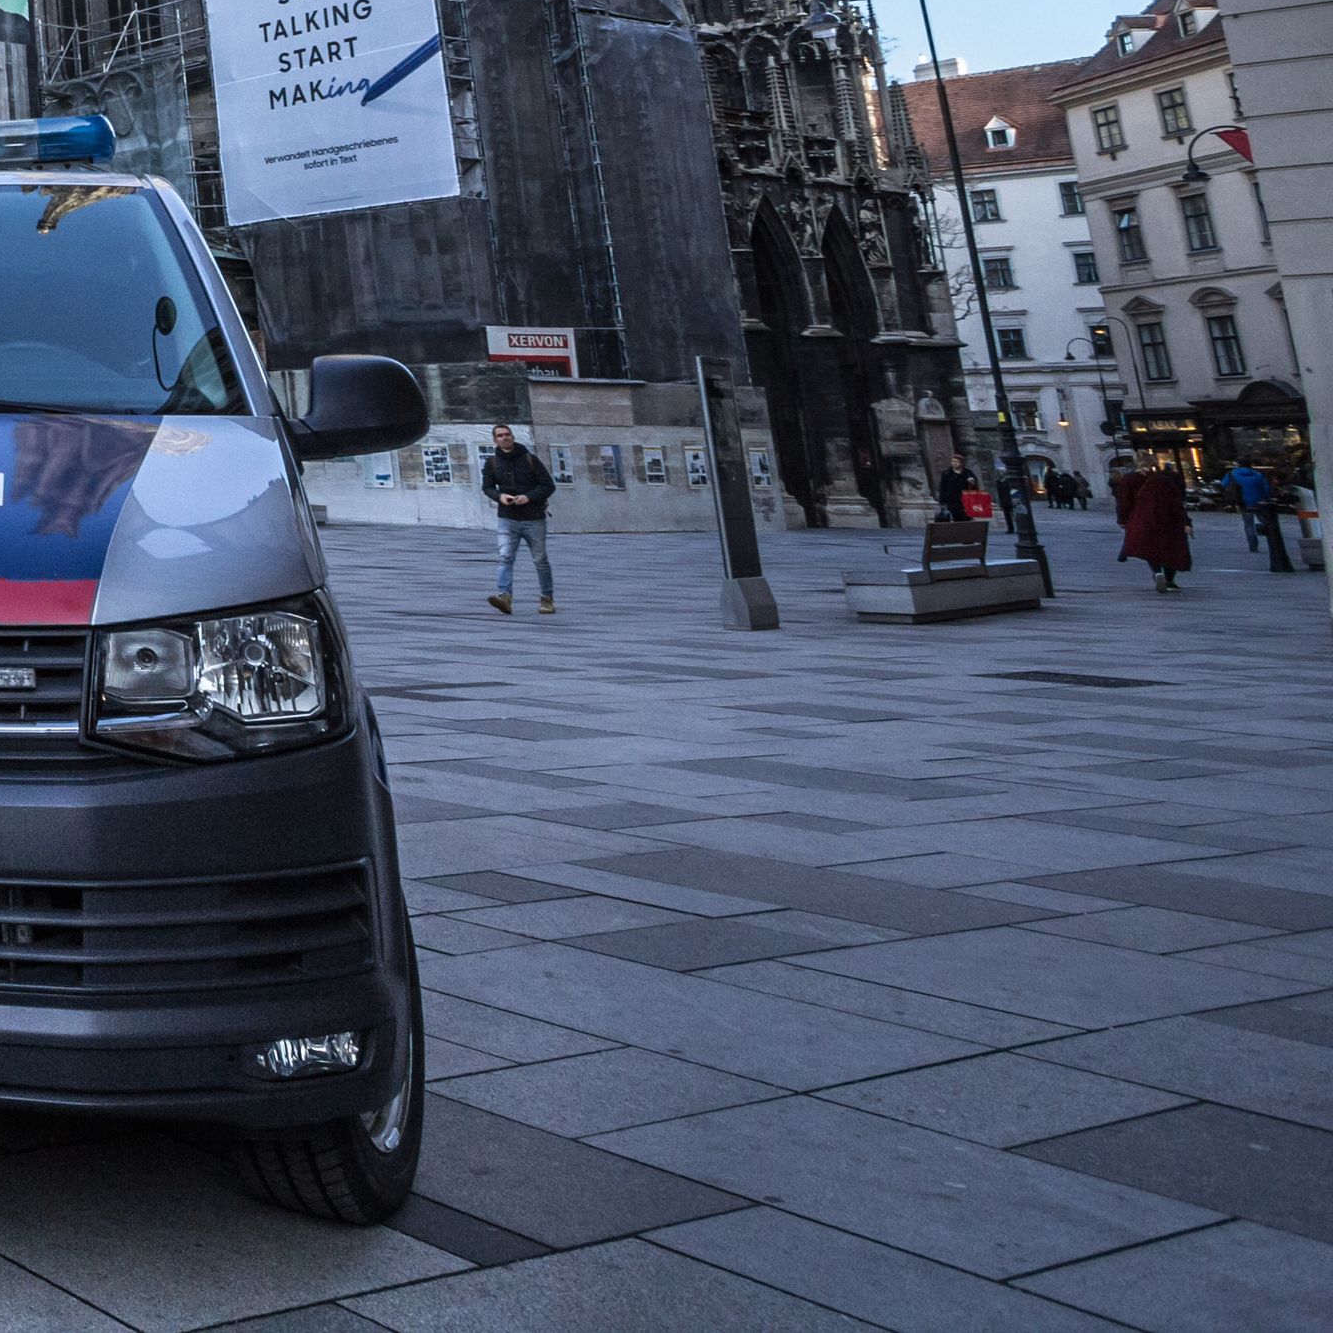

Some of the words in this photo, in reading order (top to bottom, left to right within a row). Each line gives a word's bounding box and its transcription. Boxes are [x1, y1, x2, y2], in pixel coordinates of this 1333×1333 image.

[278, 36, 358, 73] START
[269, 76, 370, 110] MAKing
[264, 150, 311, 164] Verwandelt
[311, 136, 399, 157] Handgeschriebenes
[303, 156, 329, 170] sofort
[330, 155, 338, 166] in
[339, 154, 358, 164] Text
[509, 334, 564, 347] XERVON
